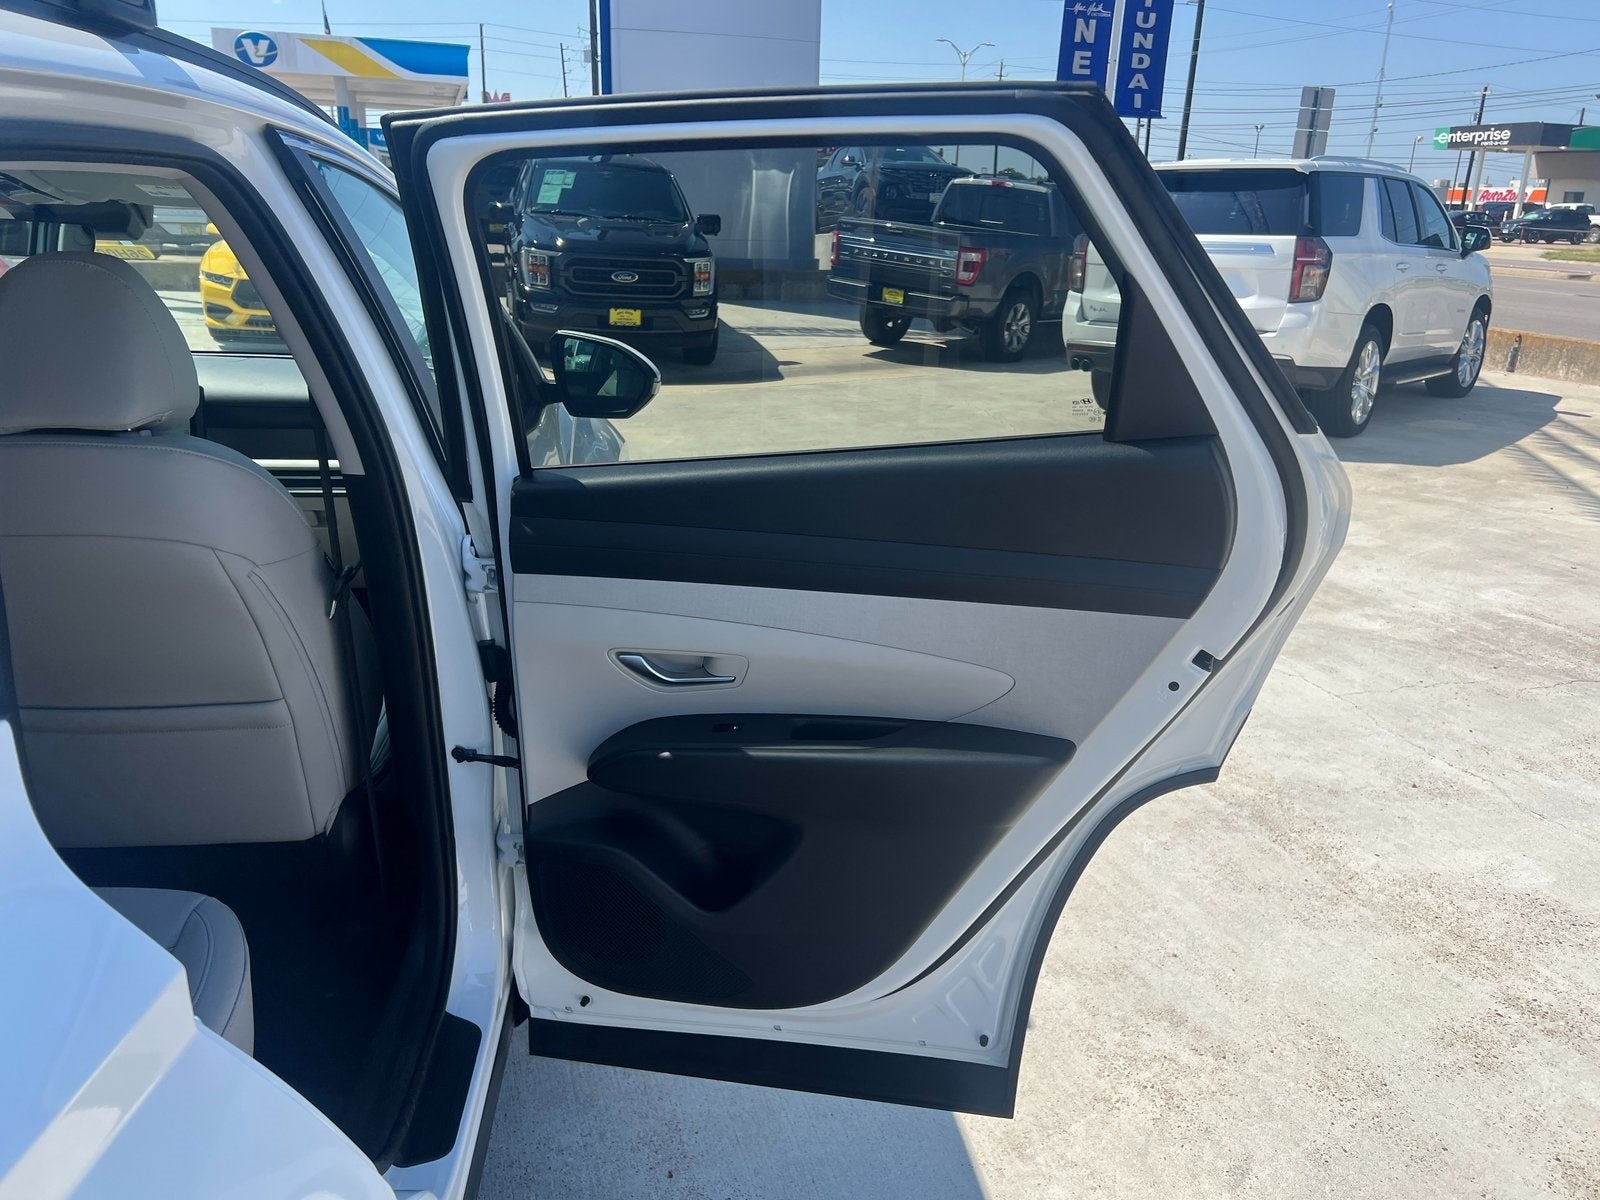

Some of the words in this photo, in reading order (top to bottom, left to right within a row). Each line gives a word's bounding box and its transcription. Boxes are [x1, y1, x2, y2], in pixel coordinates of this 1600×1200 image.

[1128, 0, 1157, 109] UNDAI
[1435, 127, 1511, 145] enterprise
[1479, 189, 1528, 201] AutoZoe
